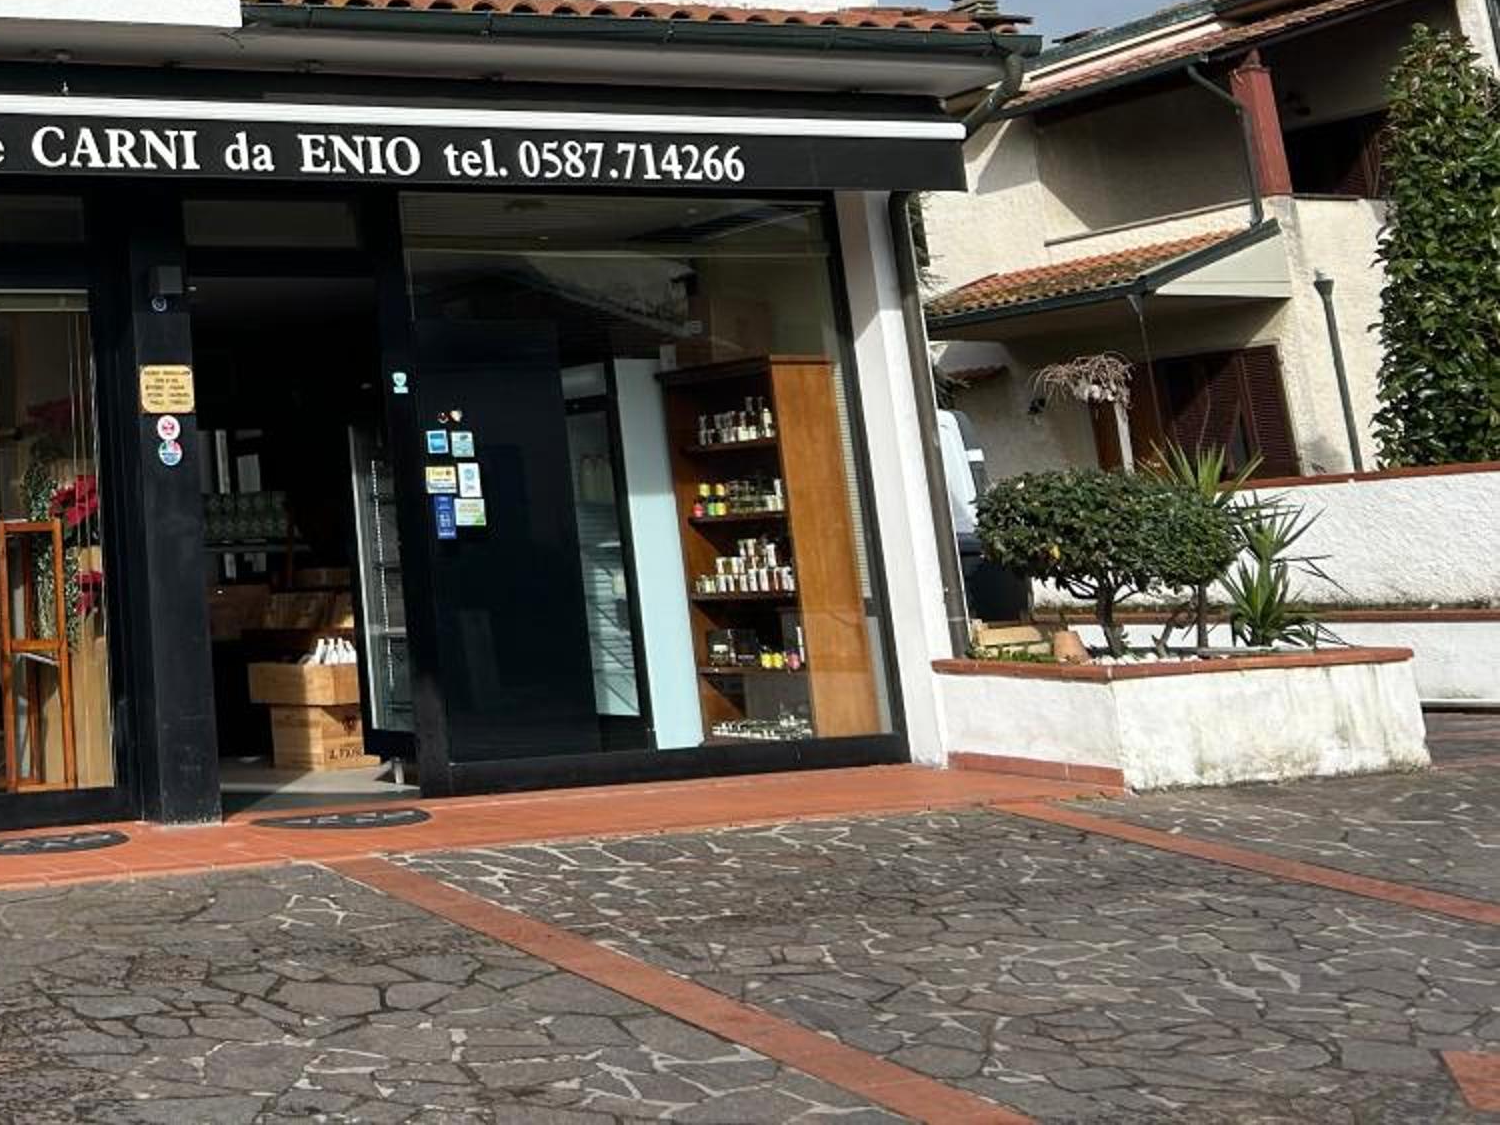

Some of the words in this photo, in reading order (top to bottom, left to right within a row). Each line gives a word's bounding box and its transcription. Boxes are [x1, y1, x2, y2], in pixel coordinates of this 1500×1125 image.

[31, 124, 201, 171] CARNI
[224, 129, 277, 173] da
[296, 132, 421, 177] ENIO
[443, 137, 510, 180] tel.
[517, 139, 746, 183] 0587.714266
